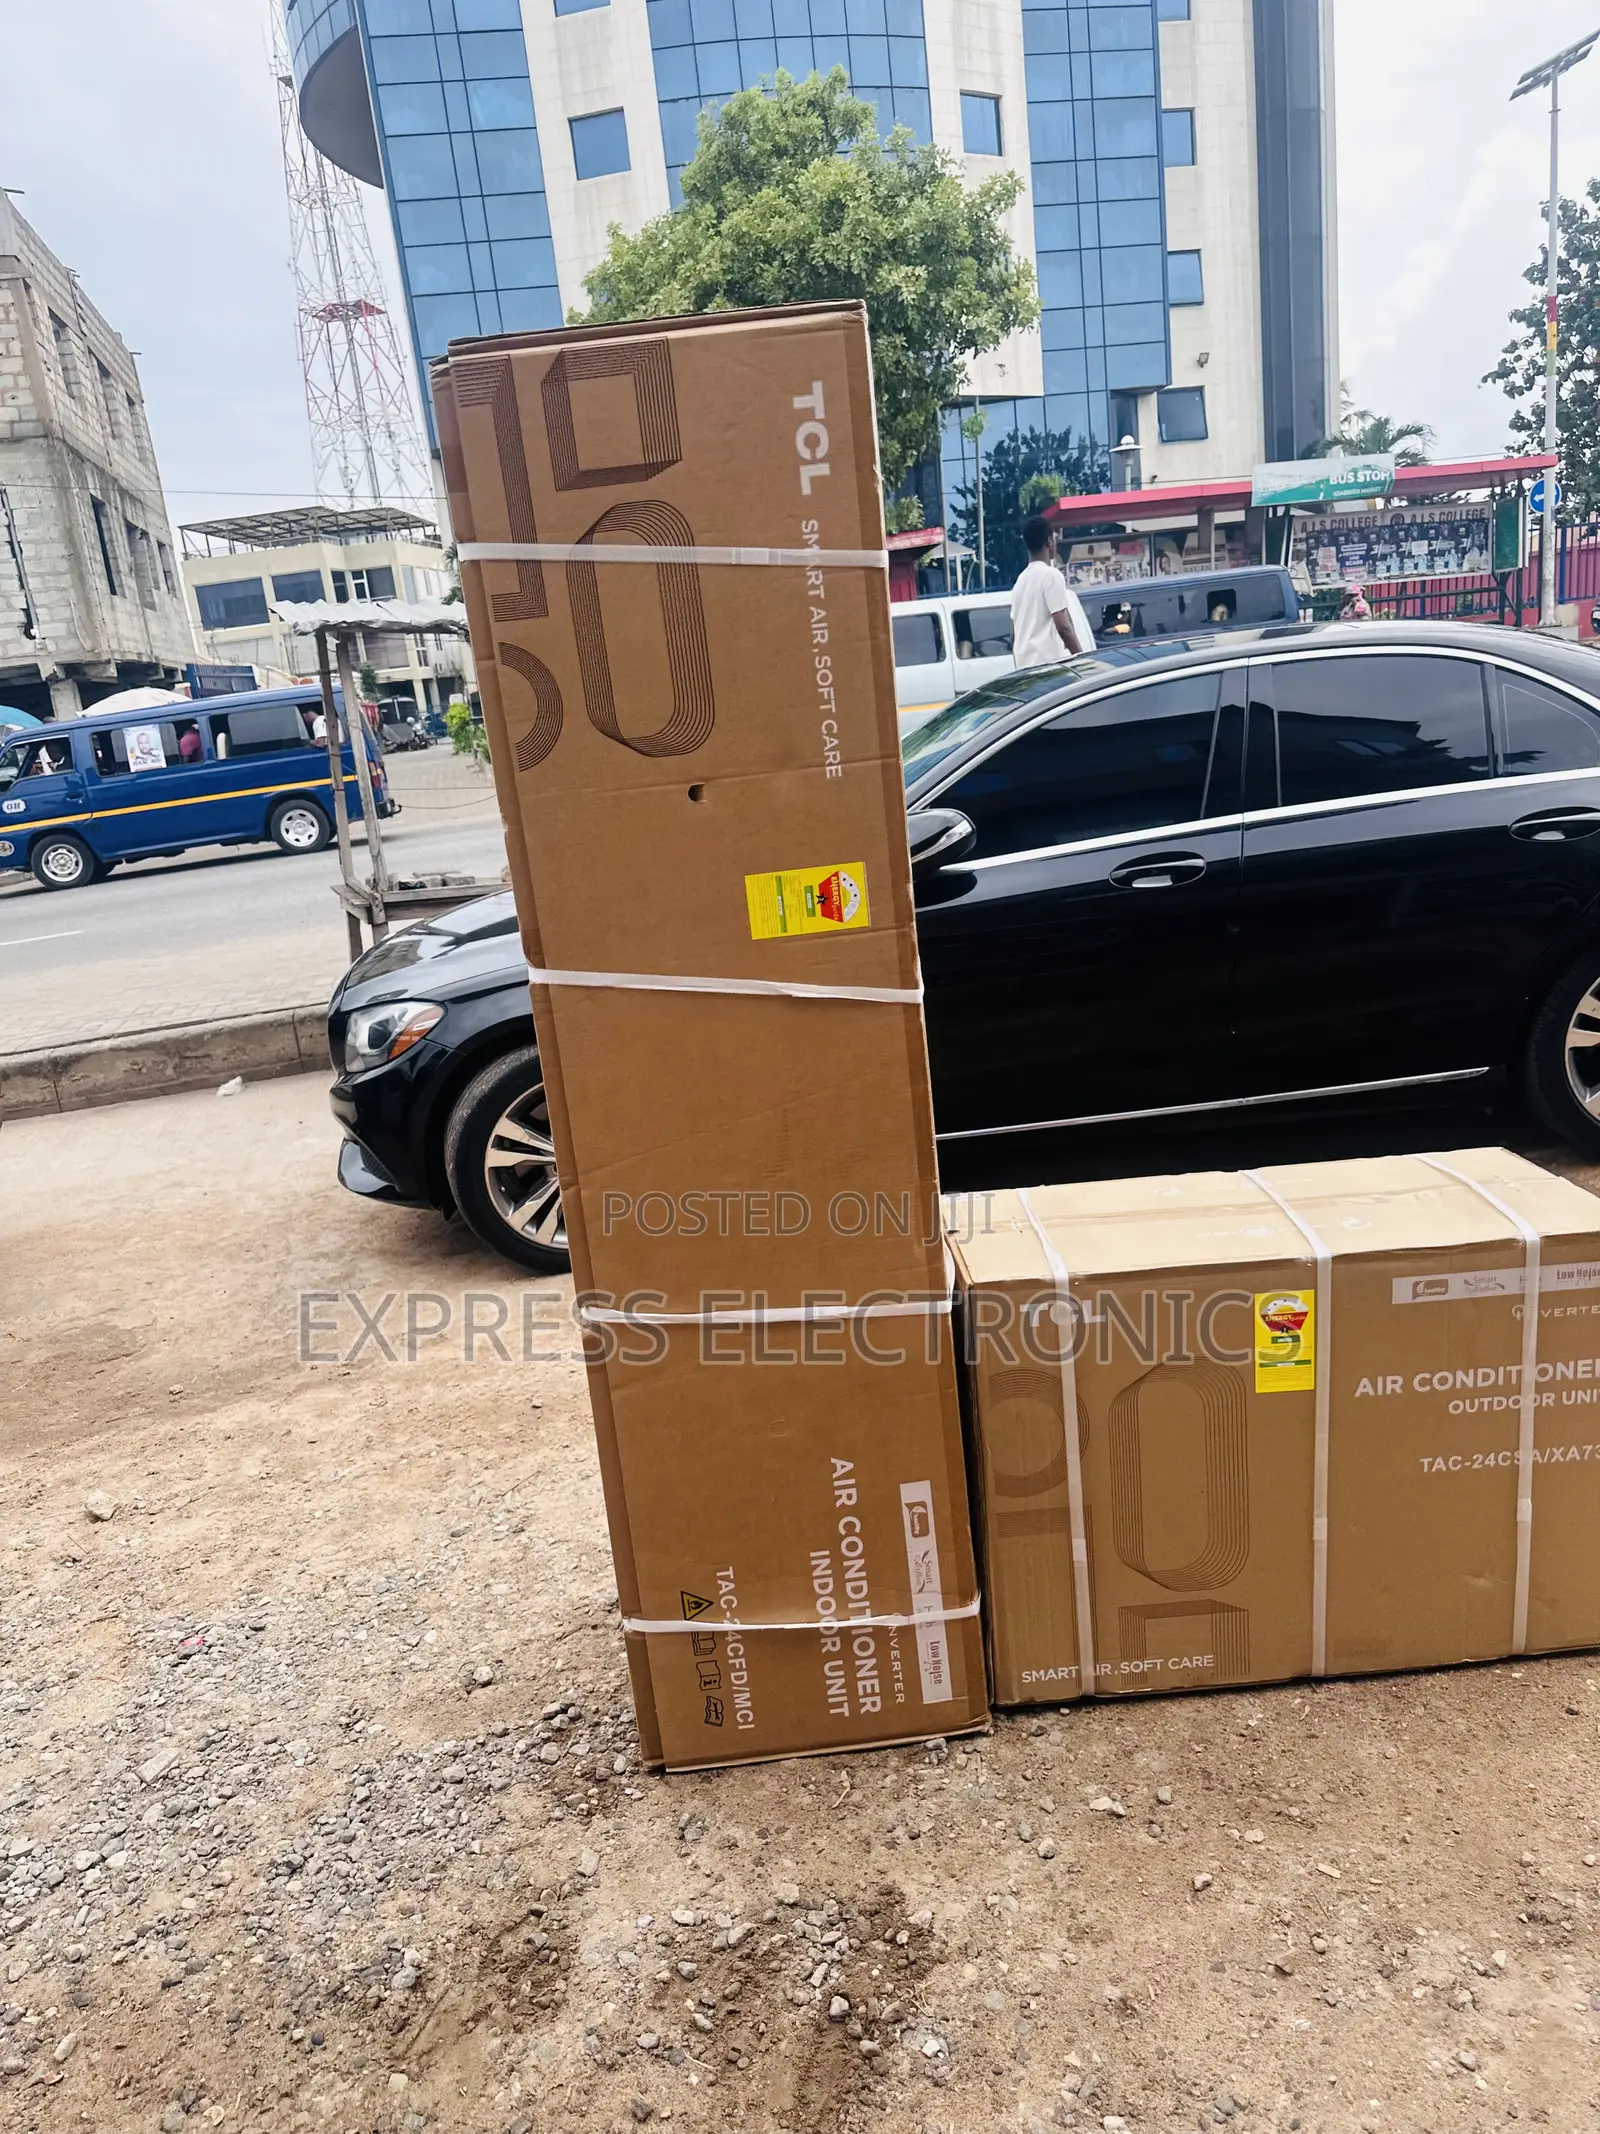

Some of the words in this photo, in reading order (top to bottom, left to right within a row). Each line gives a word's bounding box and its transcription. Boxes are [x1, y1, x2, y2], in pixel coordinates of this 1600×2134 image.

[793, 379, 831, 496] TCL
[1329, 471, 1355, 485] BUS
[1356, 469, 1390, 483] STOP
[1329, 515, 1379, 531] COLLEGE
[1438, 507, 1486, 522] COLLEGE
[814, 655, 836, 713] SOFT
[821, 719, 842, 780] CARE
[1354, 1375, 1404, 1398] AIR
[831, 1456, 858, 1508] AIR
[810, 1549, 841, 1654] INDOOR
[838, 1515, 882, 1714] CONDITIONER
[929, 1640, 941, 1659] Low
[1021, 1665, 1080, 1684] SMART
[1119, 1659, 1164, 1675] SOFT
[1167, 1654, 1214, 1670] CARE
[823, 1659, 850, 1718] UNIT
